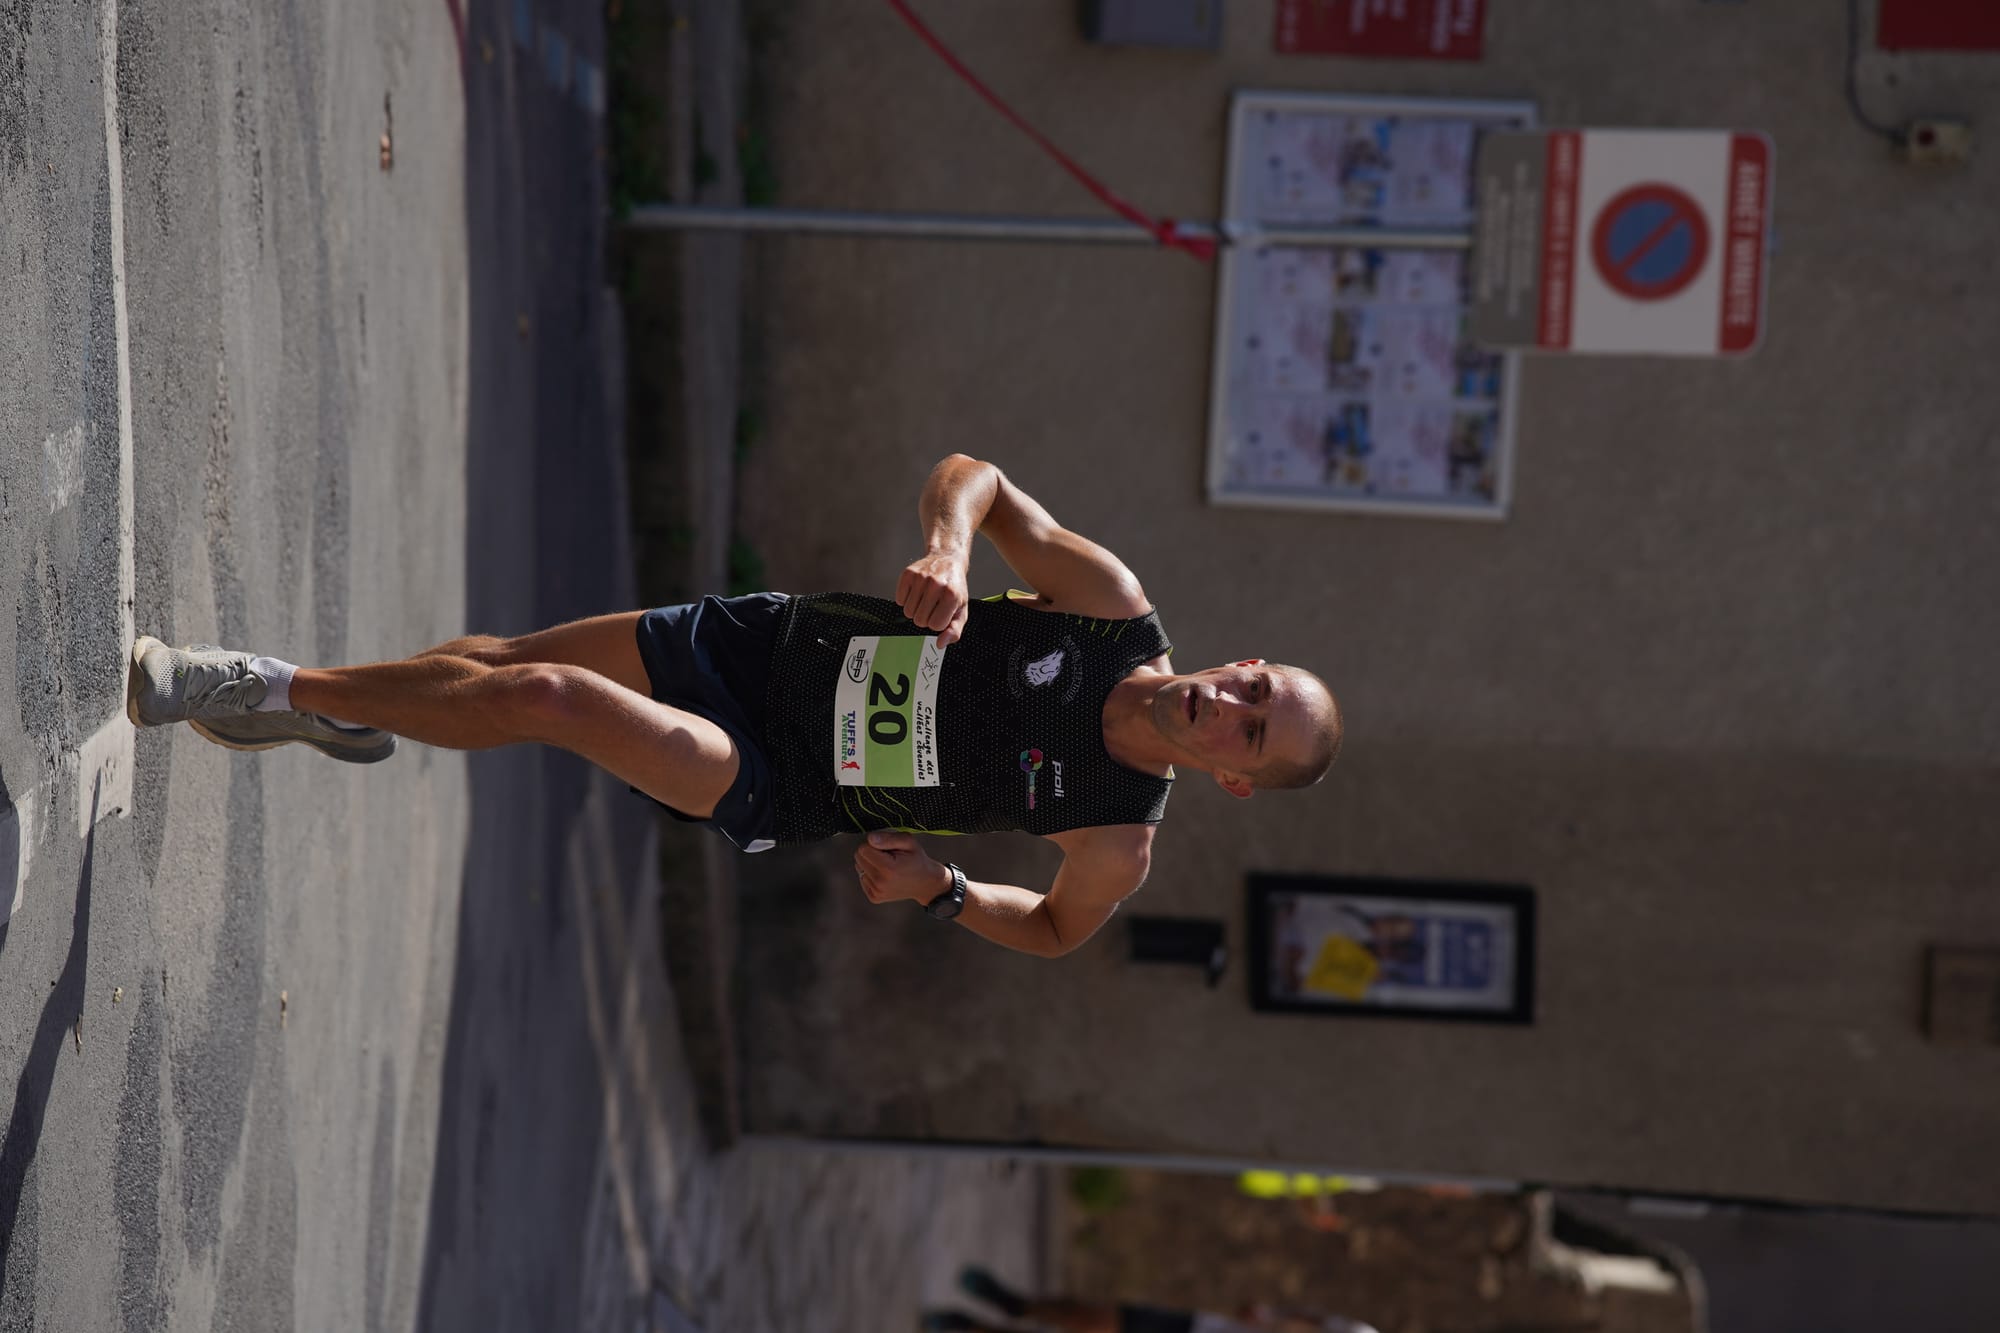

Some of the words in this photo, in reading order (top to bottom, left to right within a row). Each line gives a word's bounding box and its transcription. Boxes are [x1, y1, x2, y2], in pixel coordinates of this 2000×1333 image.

[853, 649, 867, 678] BFP
[868, 672, 910, 745] 20
[916, 700, 925, 735] vallées
[841, 714, 849, 761] Aventure
[847, 710, 856, 756] TUFF'S
[922, 706, 933, 755] Challenge
[916, 740, 925, 780] cévenoles
[926, 757, 934, 776] des
[1052, 760, 1065, 798] poli
